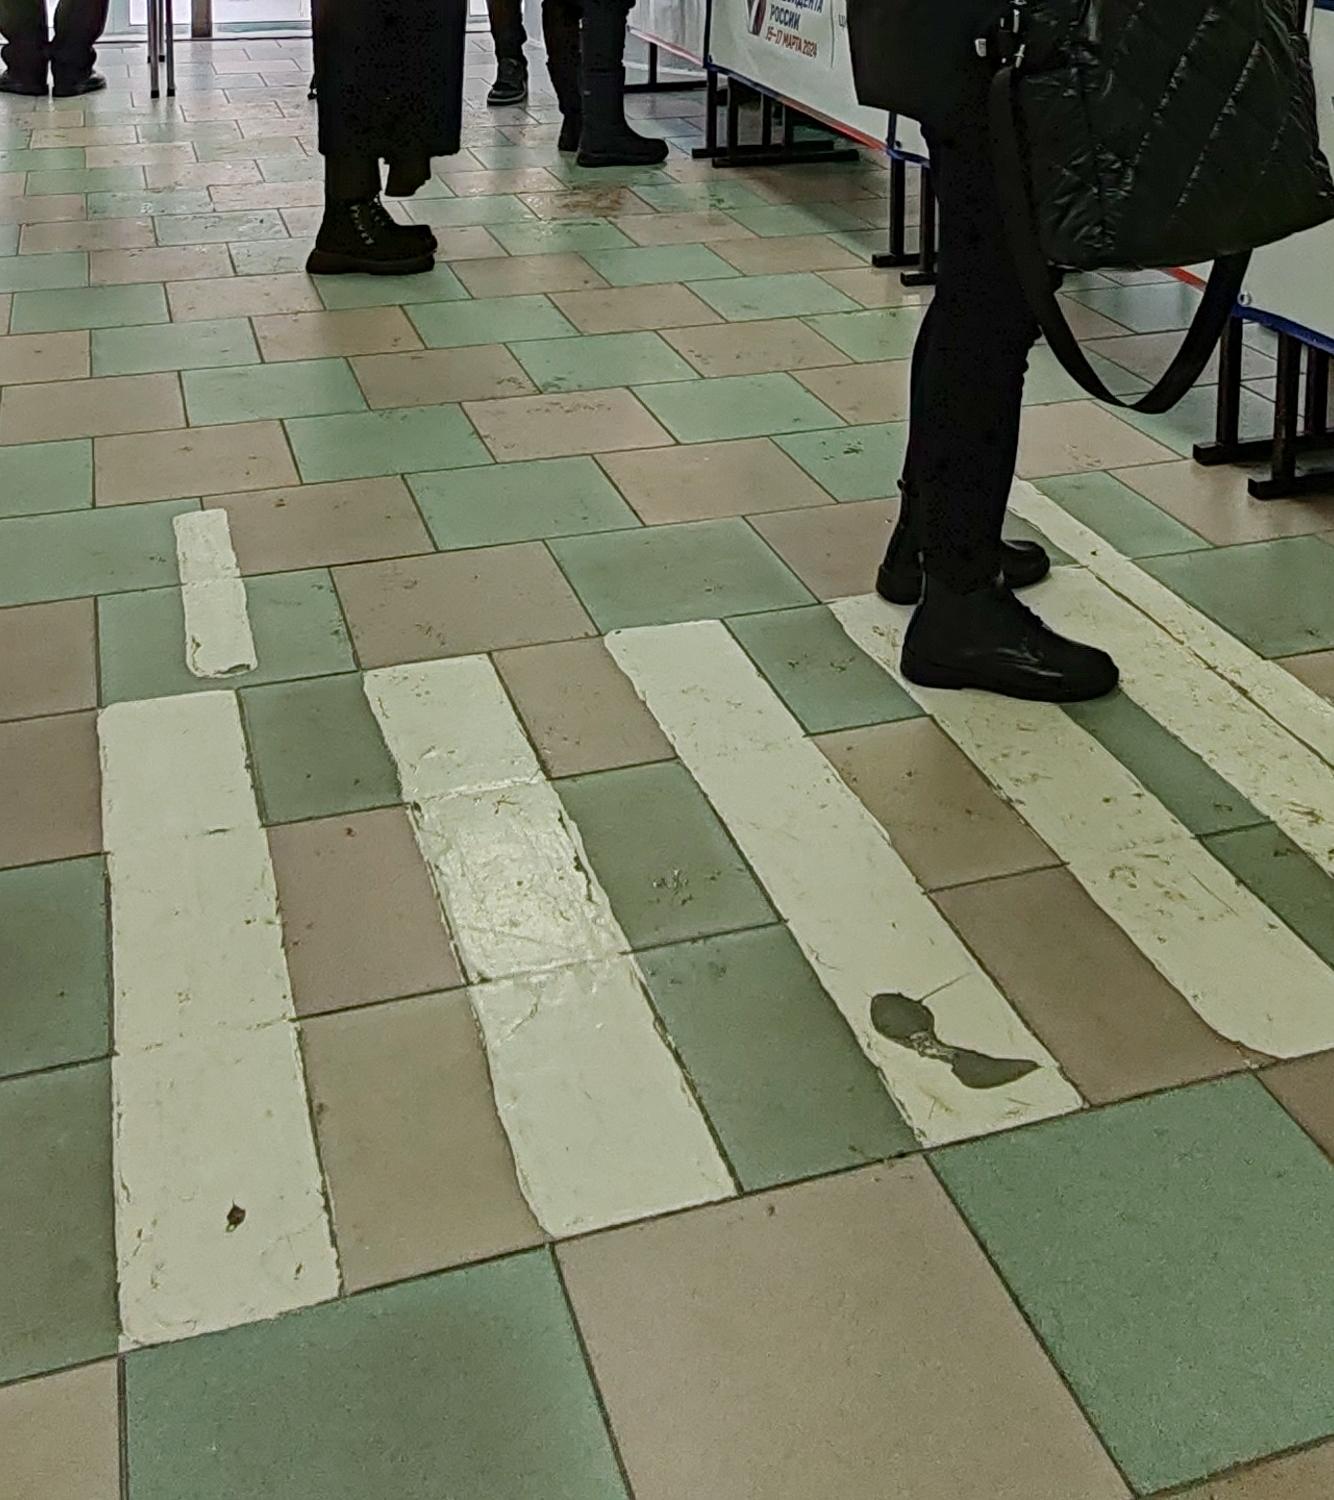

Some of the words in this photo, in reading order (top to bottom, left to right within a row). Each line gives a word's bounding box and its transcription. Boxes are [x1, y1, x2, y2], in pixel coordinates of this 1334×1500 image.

[769, 4, 801, 31] РОССИИ
[782, 32, 803, 51] МАРТА
[802, 39, 818, 58] 2024
